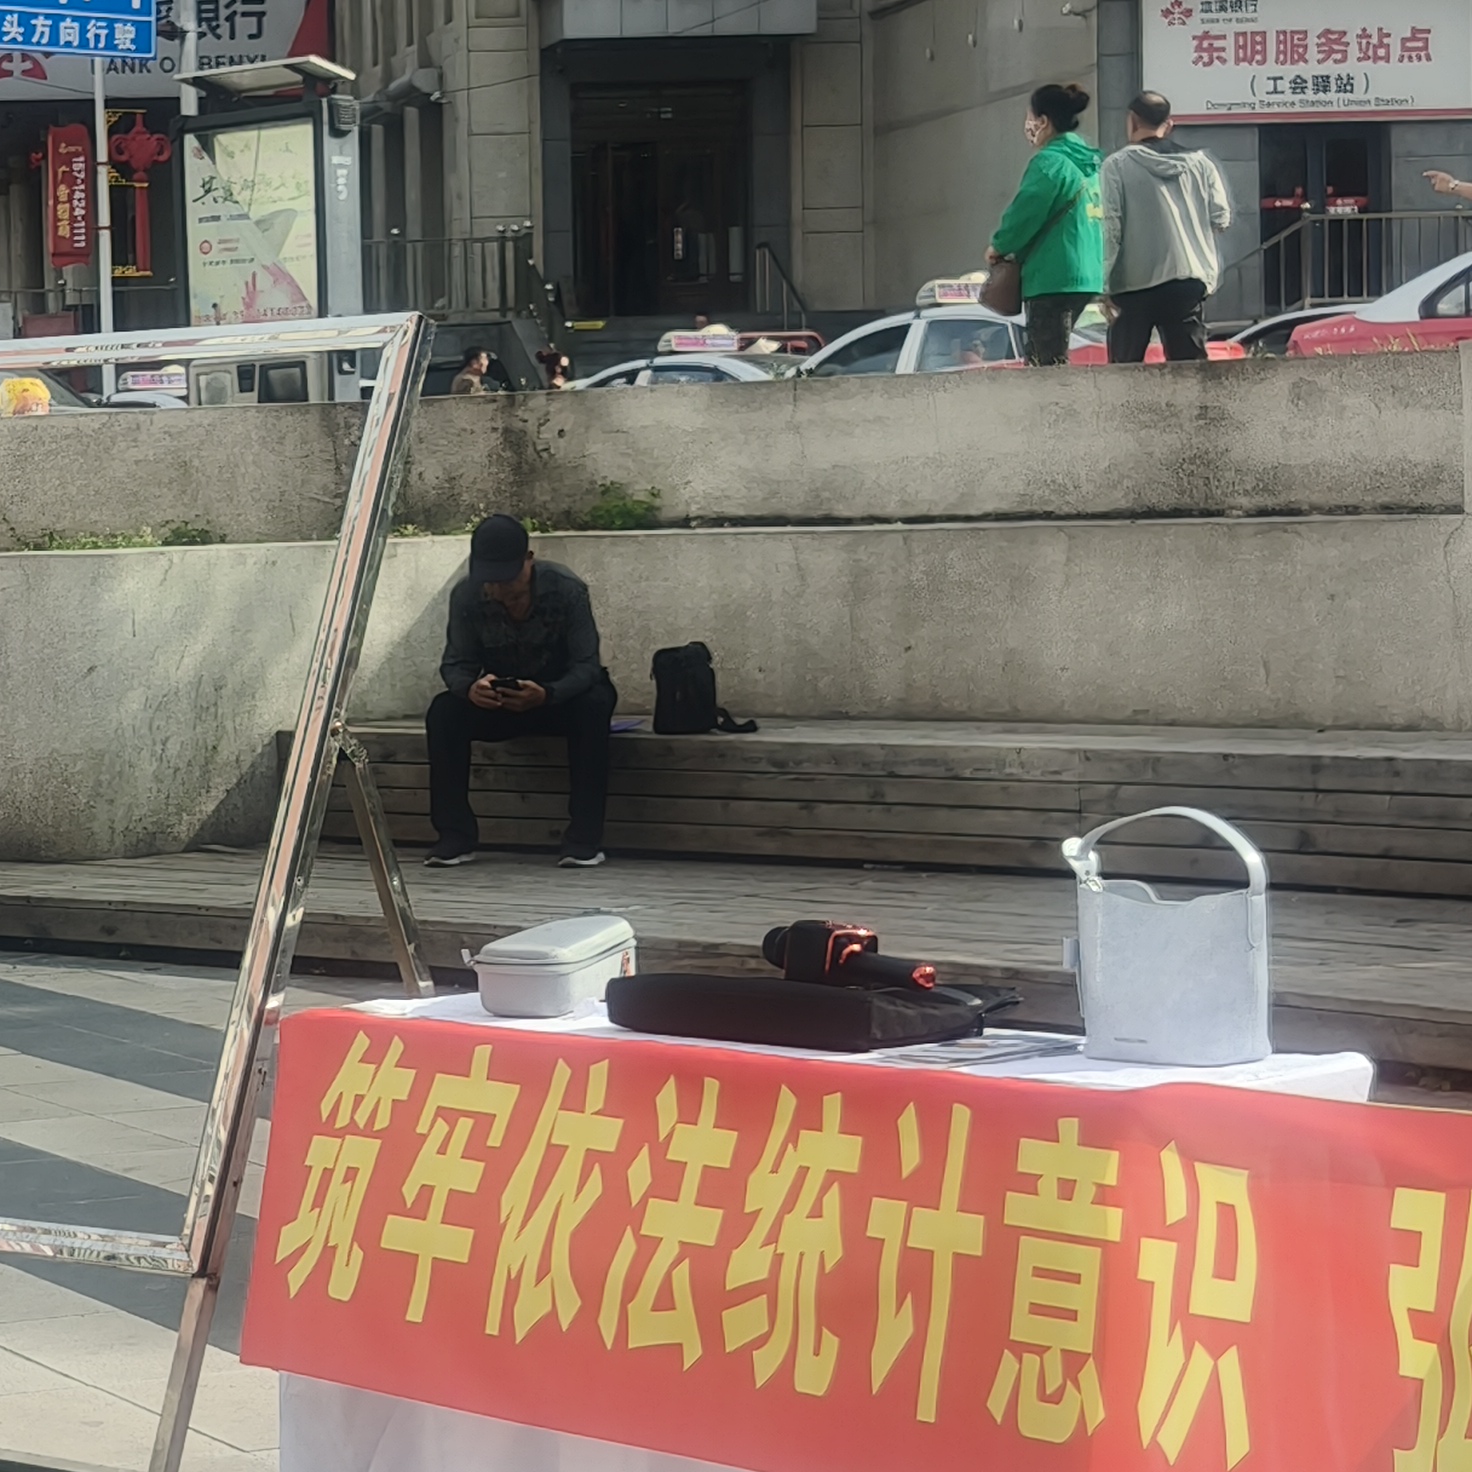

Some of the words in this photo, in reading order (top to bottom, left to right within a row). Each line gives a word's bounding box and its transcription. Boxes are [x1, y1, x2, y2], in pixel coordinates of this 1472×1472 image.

[1191, 26, 1433, 67] 东明服务站点
[1259, 99, 1296, 109] Service
[1298, 98, 1334, 108] Station
[275, 1030, 1256, 1472] 筑牢依法统计意识
